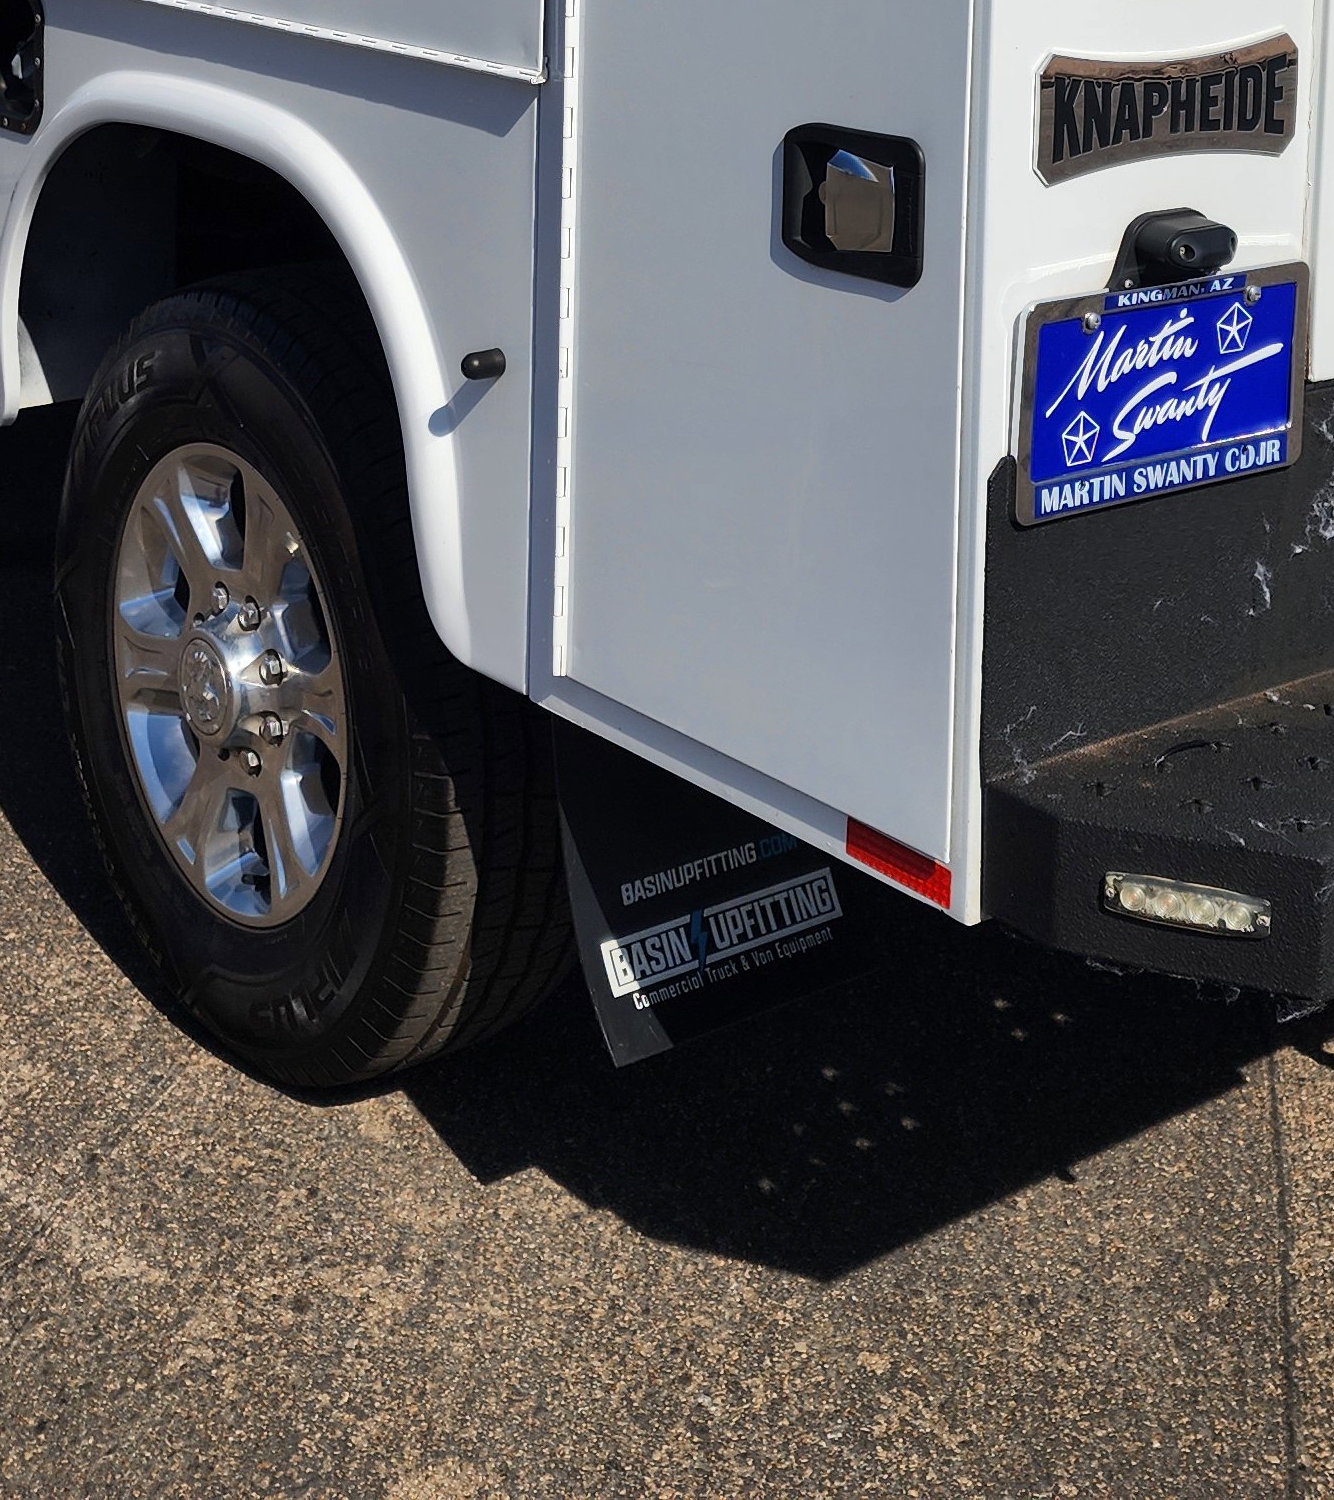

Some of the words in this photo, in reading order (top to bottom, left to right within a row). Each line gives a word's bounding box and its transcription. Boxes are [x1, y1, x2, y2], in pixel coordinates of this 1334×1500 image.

[1051, 53, 1289, 164] KNAPHEIDE
[1209, 277, 1235, 292] AZ
[1046, 307, 1199, 418] Martin
[1101, 343, 1284, 463] Swanty
[1041, 471, 1126, 515] MARTIN
[1133, 451, 1219, 493] SWANTY
[1224, 439, 1281, 473] CDJR
[612, 926, 693, 986] BASIN
[708, 879, 833, 950] UPFITTING
[633, 972, 704, 1010] Commercial
[705, 958, 743, 982] Truck
[742, 956, 751, 971] &
[752, 949, 774, 967] Van
[776, 926, 835, 959] Equipment
